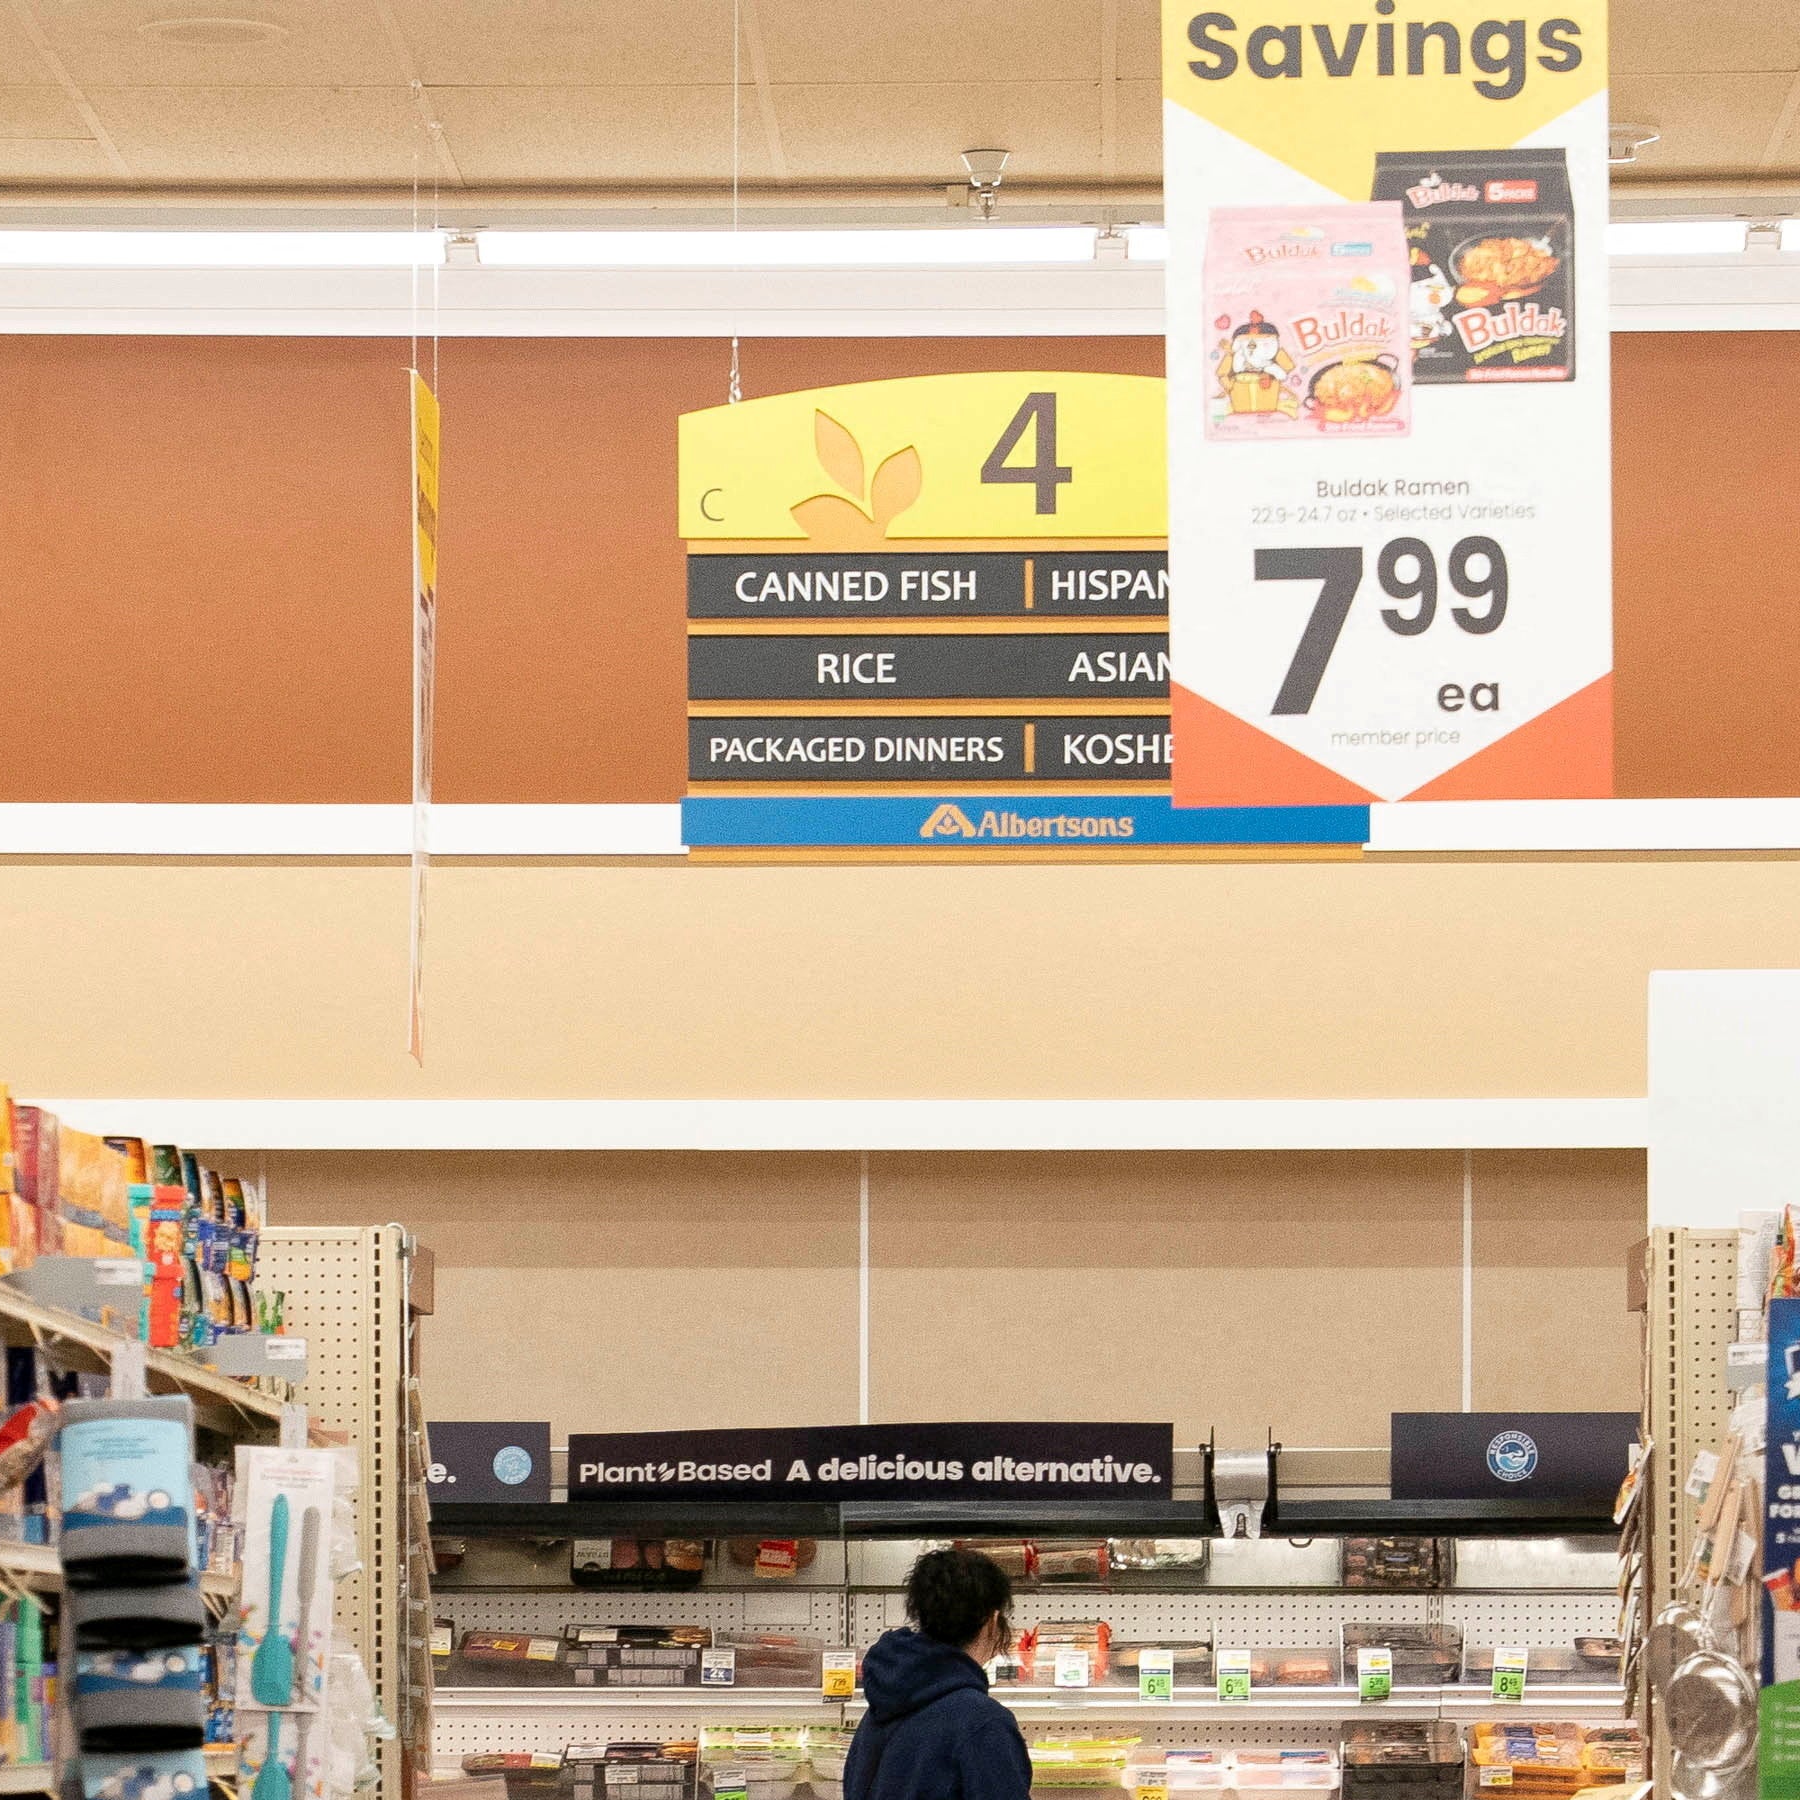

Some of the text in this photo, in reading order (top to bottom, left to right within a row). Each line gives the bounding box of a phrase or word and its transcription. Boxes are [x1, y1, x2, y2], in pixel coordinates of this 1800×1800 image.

[1187, 0, 1582, 100] Savings
[1293, 311, 1392, 351] Buldak
[1456, 303, 1566, 350] Buldak
[981, 392, 1072, 515] 4
[1317, 478, 1470, 498] Buldak Ramen
[701, 487, 725, 522] C
[1336, 508, 1358, 523] oz
[1374, 503, 1452, 523] Selected
[1459, 502, 1536, 521] Varieties
[734, 570, 977, 603] CANNED FISH
[817, 653, 897, 684] RICE
[1437, 682, 1499, 713] ea
[709, 736, 1004, 764] PACKAGED DINNERS
[1063, 733, 1175, 765] KOSHE
[1331, 728, 1461, 749] member price
[976, 810, 1134, 840] Albertsons
[580, 1453, 1162, 1484] Plant Based A delicious alternative.
